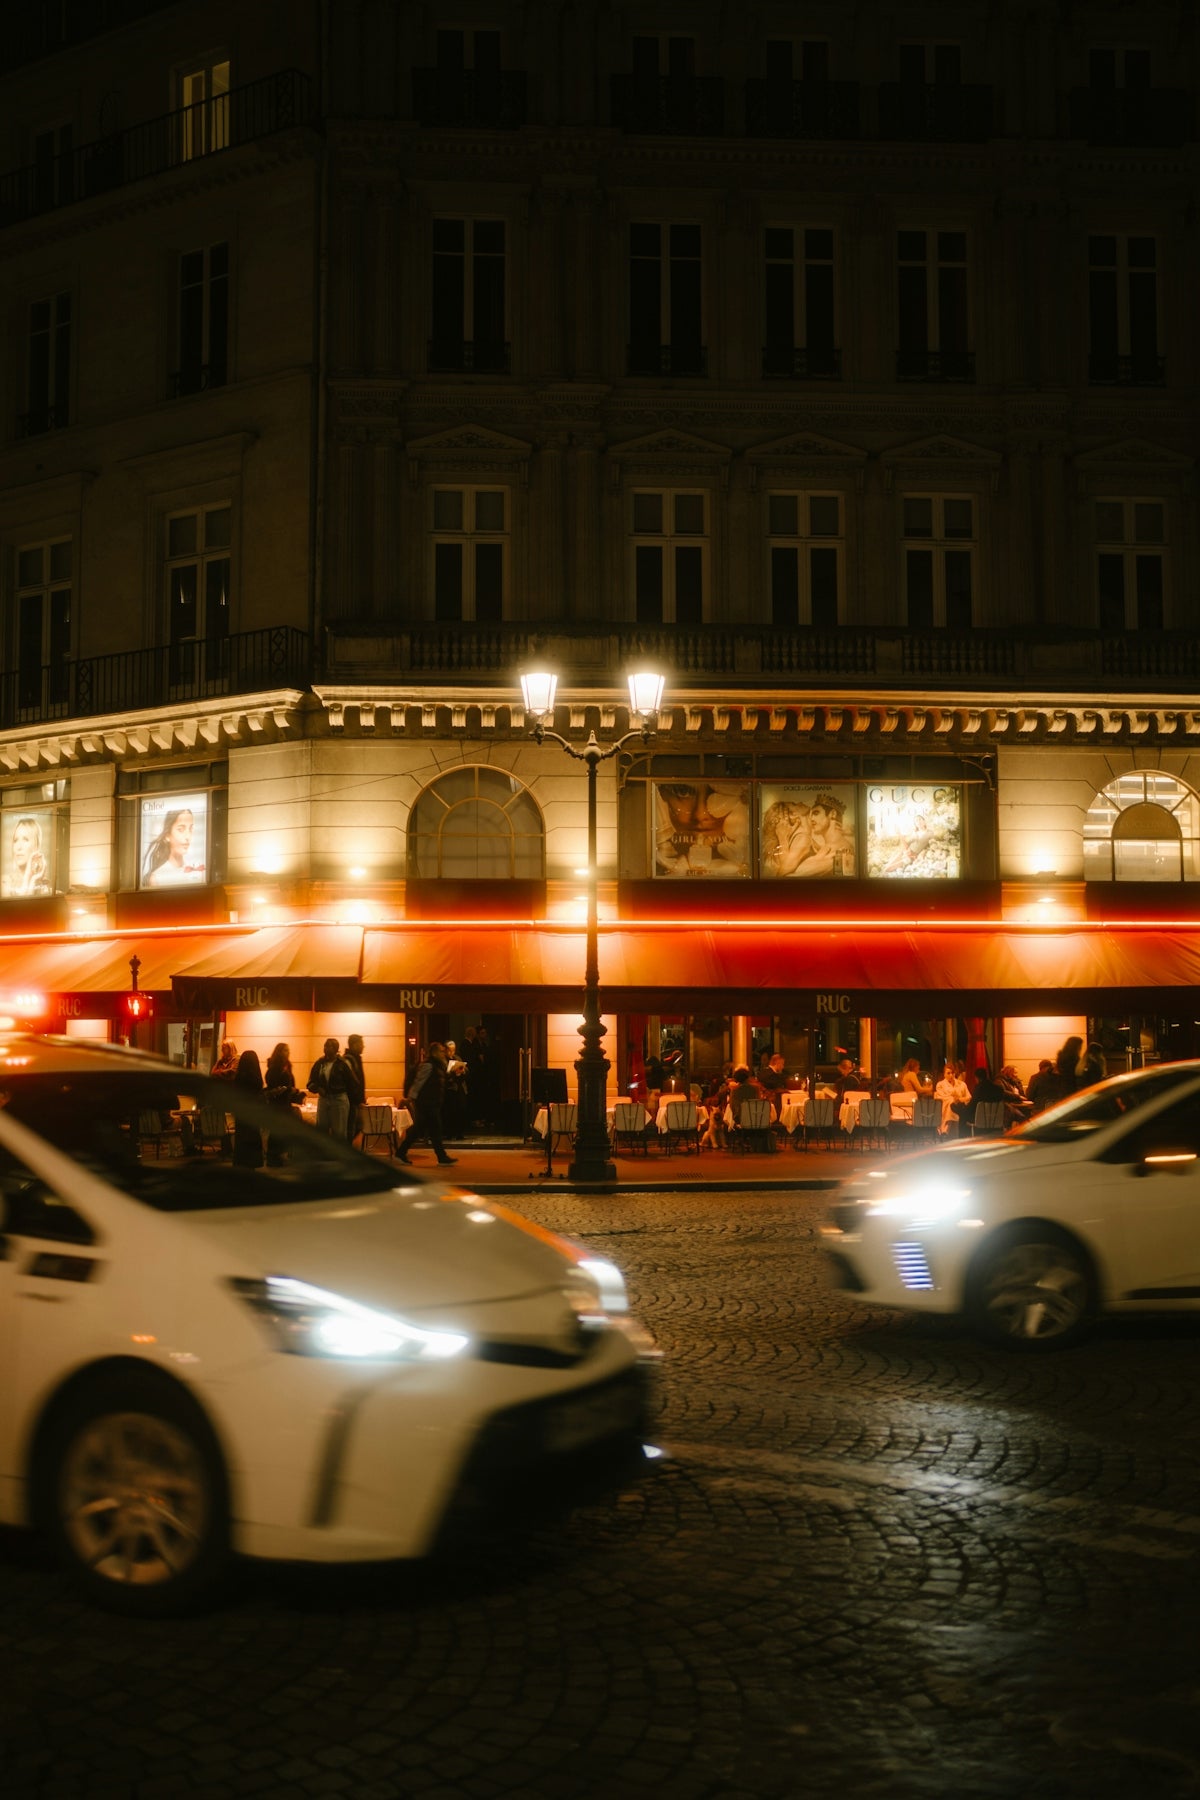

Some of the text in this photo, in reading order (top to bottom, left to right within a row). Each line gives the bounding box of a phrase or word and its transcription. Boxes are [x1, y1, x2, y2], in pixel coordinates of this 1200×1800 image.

[869, 787, 959, 804] GUCCI
[671, 835, 695, 844] GIRL
[236, 987, 269, 1007] RUC
[400, 989, 435, 1009] RUC
[816, 994, 850, 1014] RUC
[57, 998, 81, 1016] RUC
